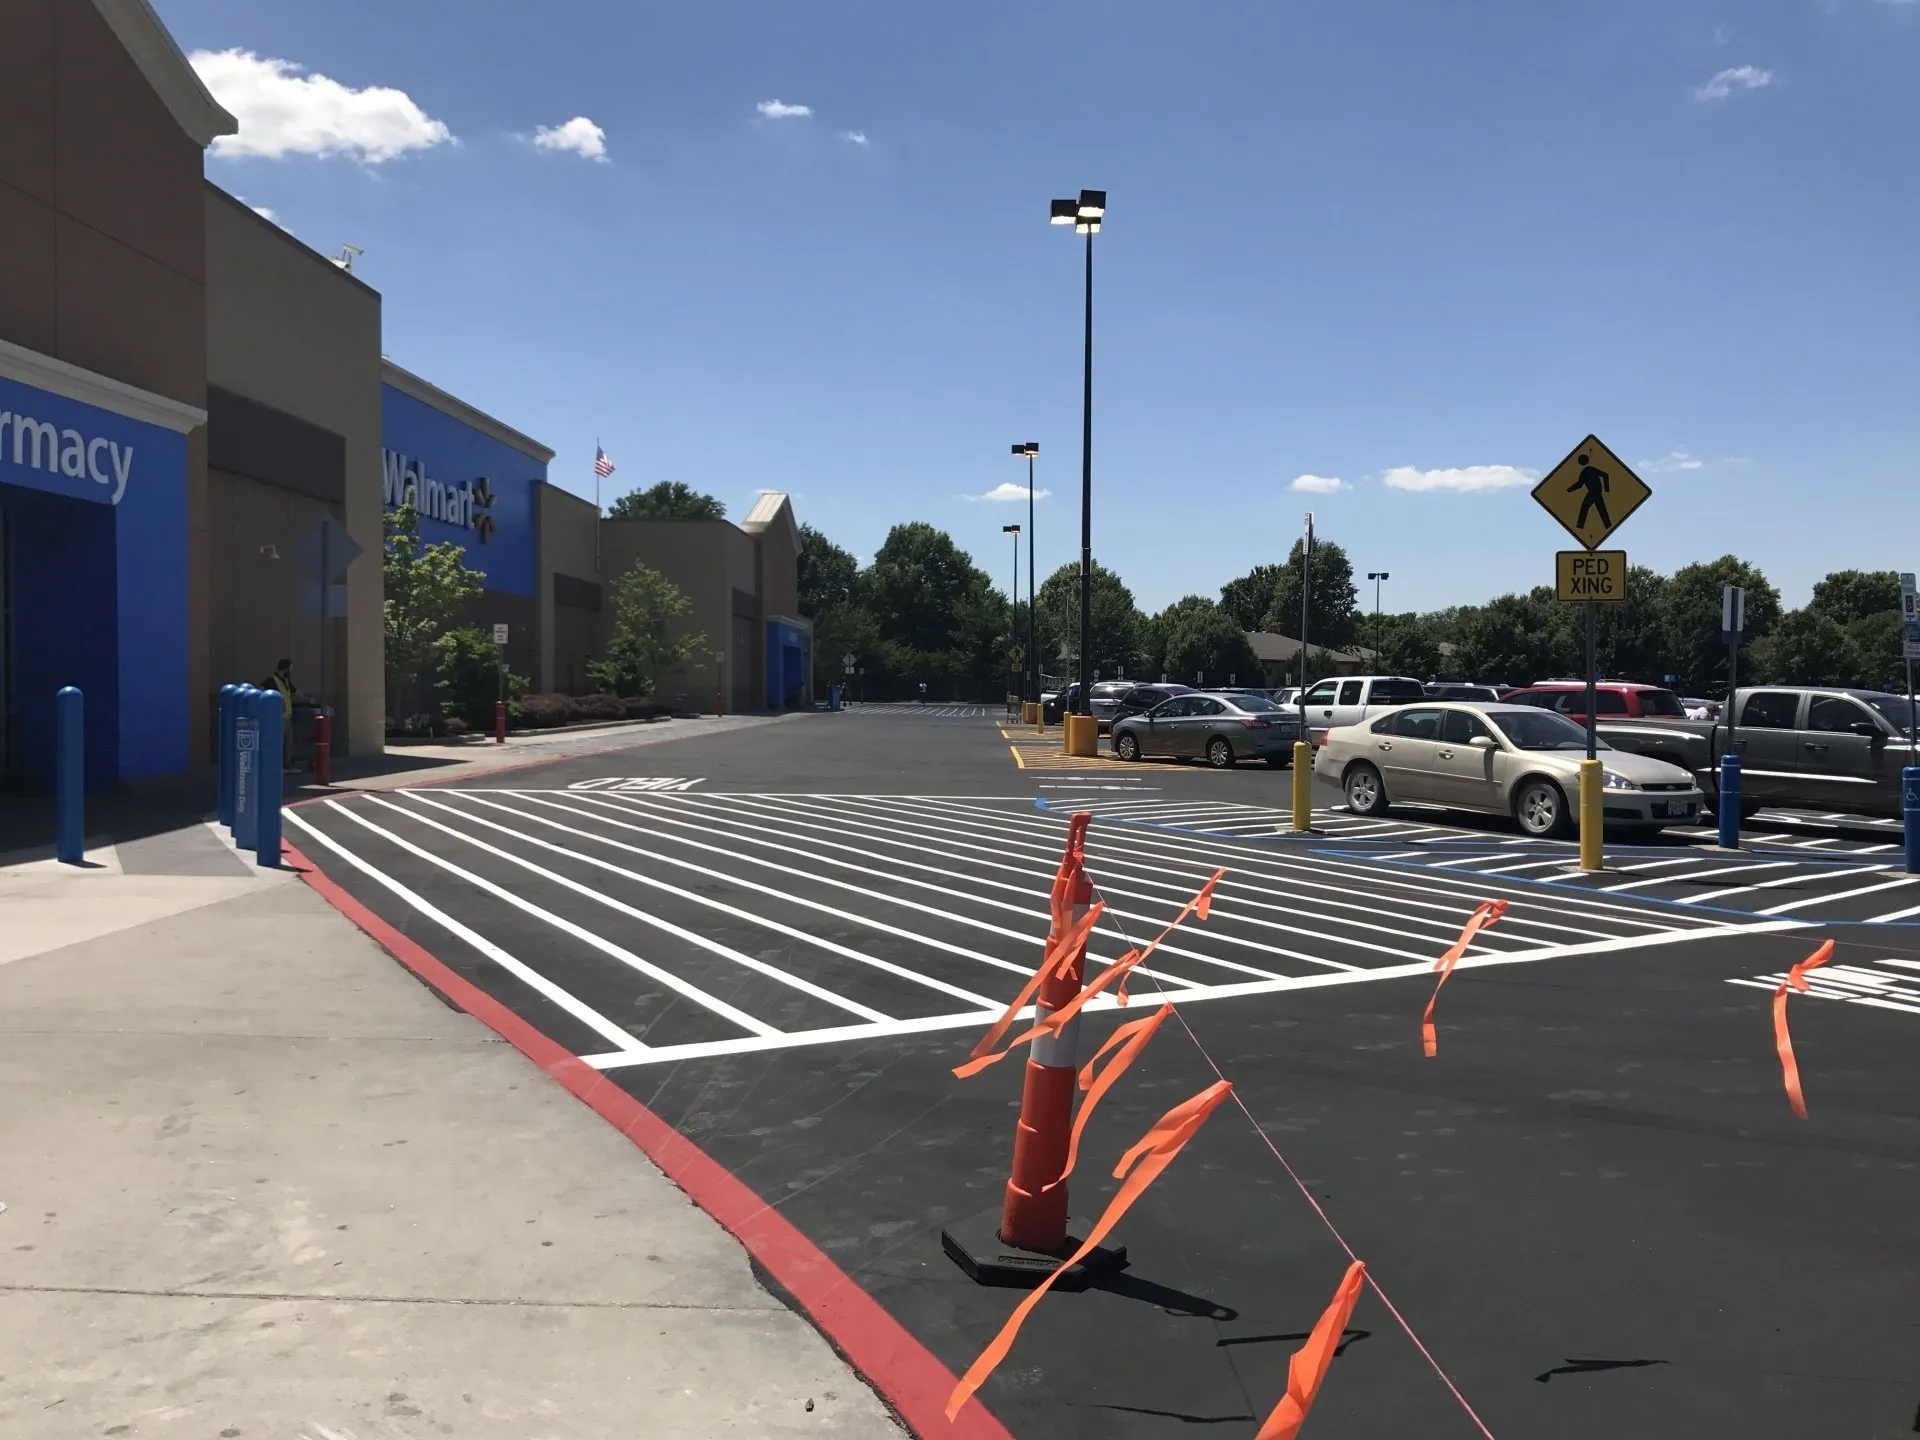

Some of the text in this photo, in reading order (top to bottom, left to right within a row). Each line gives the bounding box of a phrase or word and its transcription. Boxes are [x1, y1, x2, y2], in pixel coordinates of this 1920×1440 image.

[382, 447, 475, 529] Walmart
[1572, 558, 1609, 575] PED
[1570, 577, 1613, 594] XING
[239, 751, 250, 794] Wellness
[567, 777, 707, 790] YIELD
